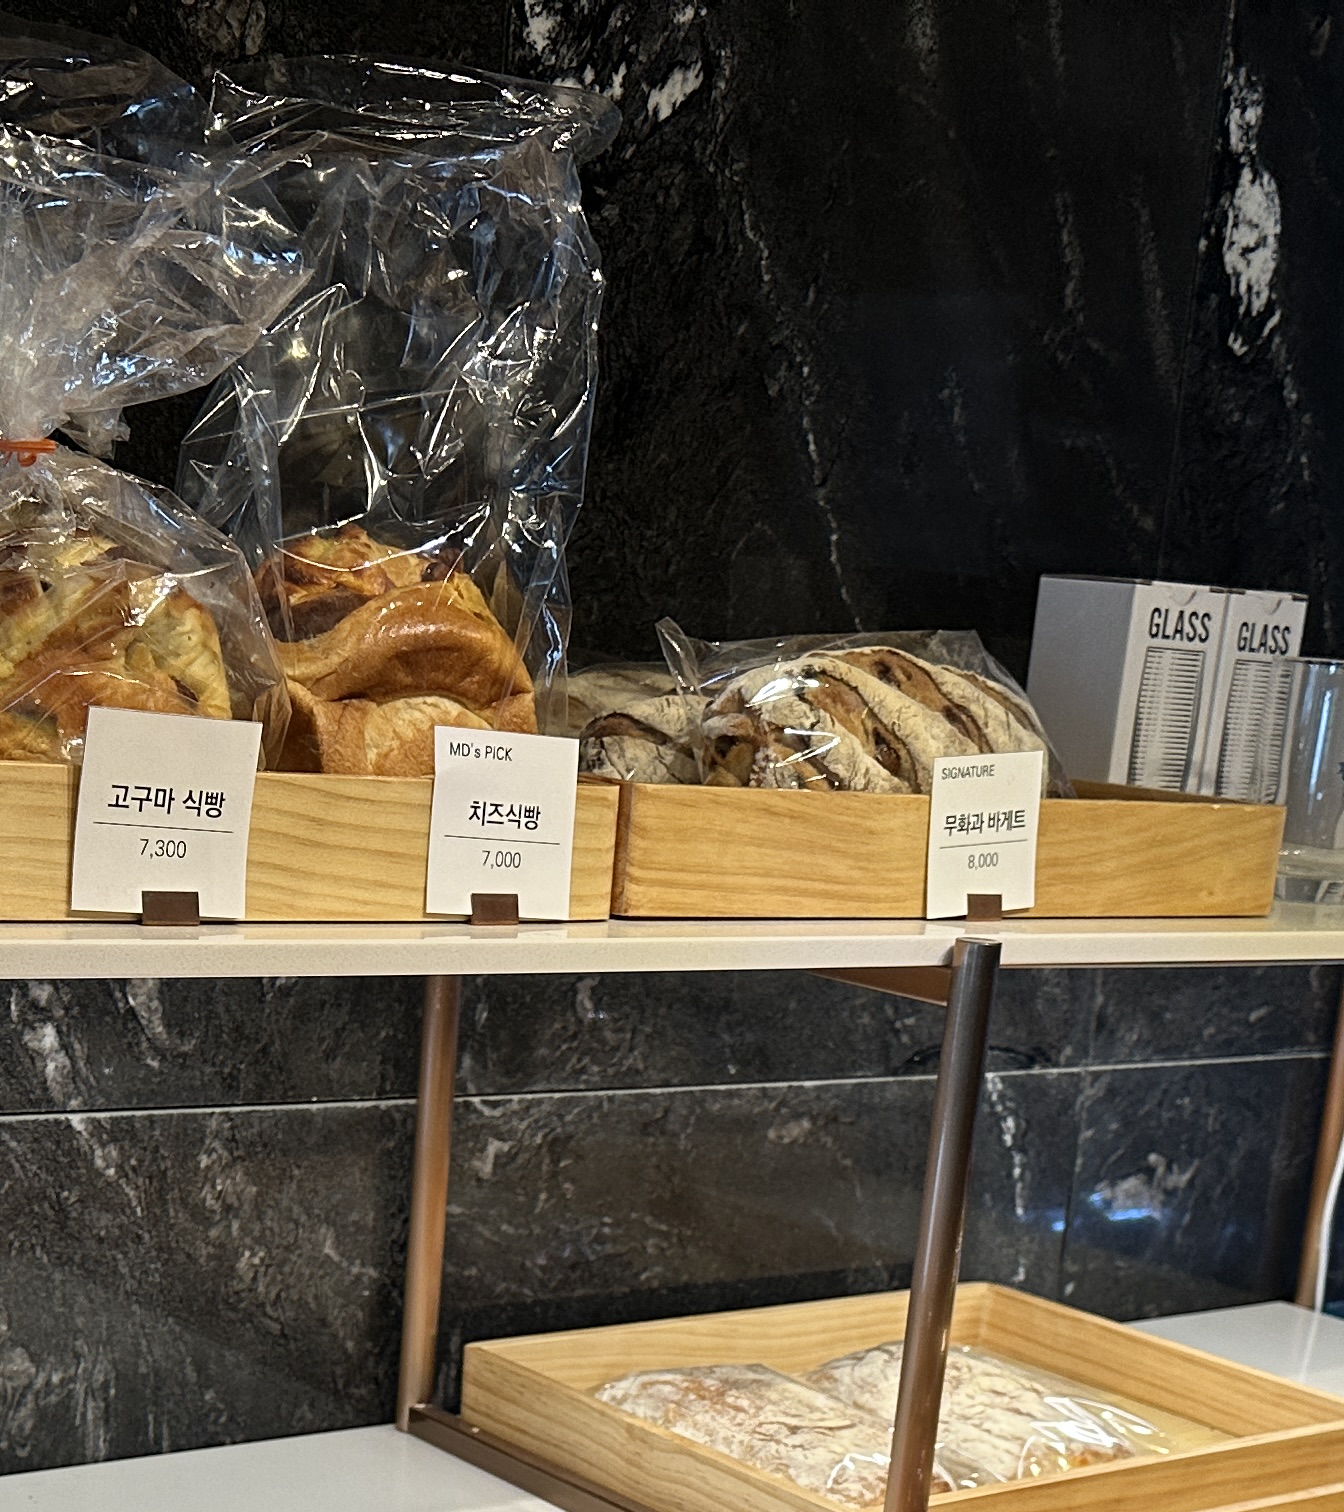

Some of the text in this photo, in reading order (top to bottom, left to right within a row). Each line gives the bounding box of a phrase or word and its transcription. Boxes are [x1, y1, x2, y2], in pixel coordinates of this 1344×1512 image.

[1149, 607, 1212, 643] GLASS
[1237, 621, 1291, 655] GLASS
[941, 764, 996, 780] SIGNATURE
[107, 784, 226, 819] 고구마 식빵
[468, 800, 541, 831] 치즈식빵
[943, 809, 1027, 837] 무화과 바게트
[139, 838, 187, 859] 7,300
[481, 850, 522, 869] 7,000
[967, 852, 999, 870] 8,000
